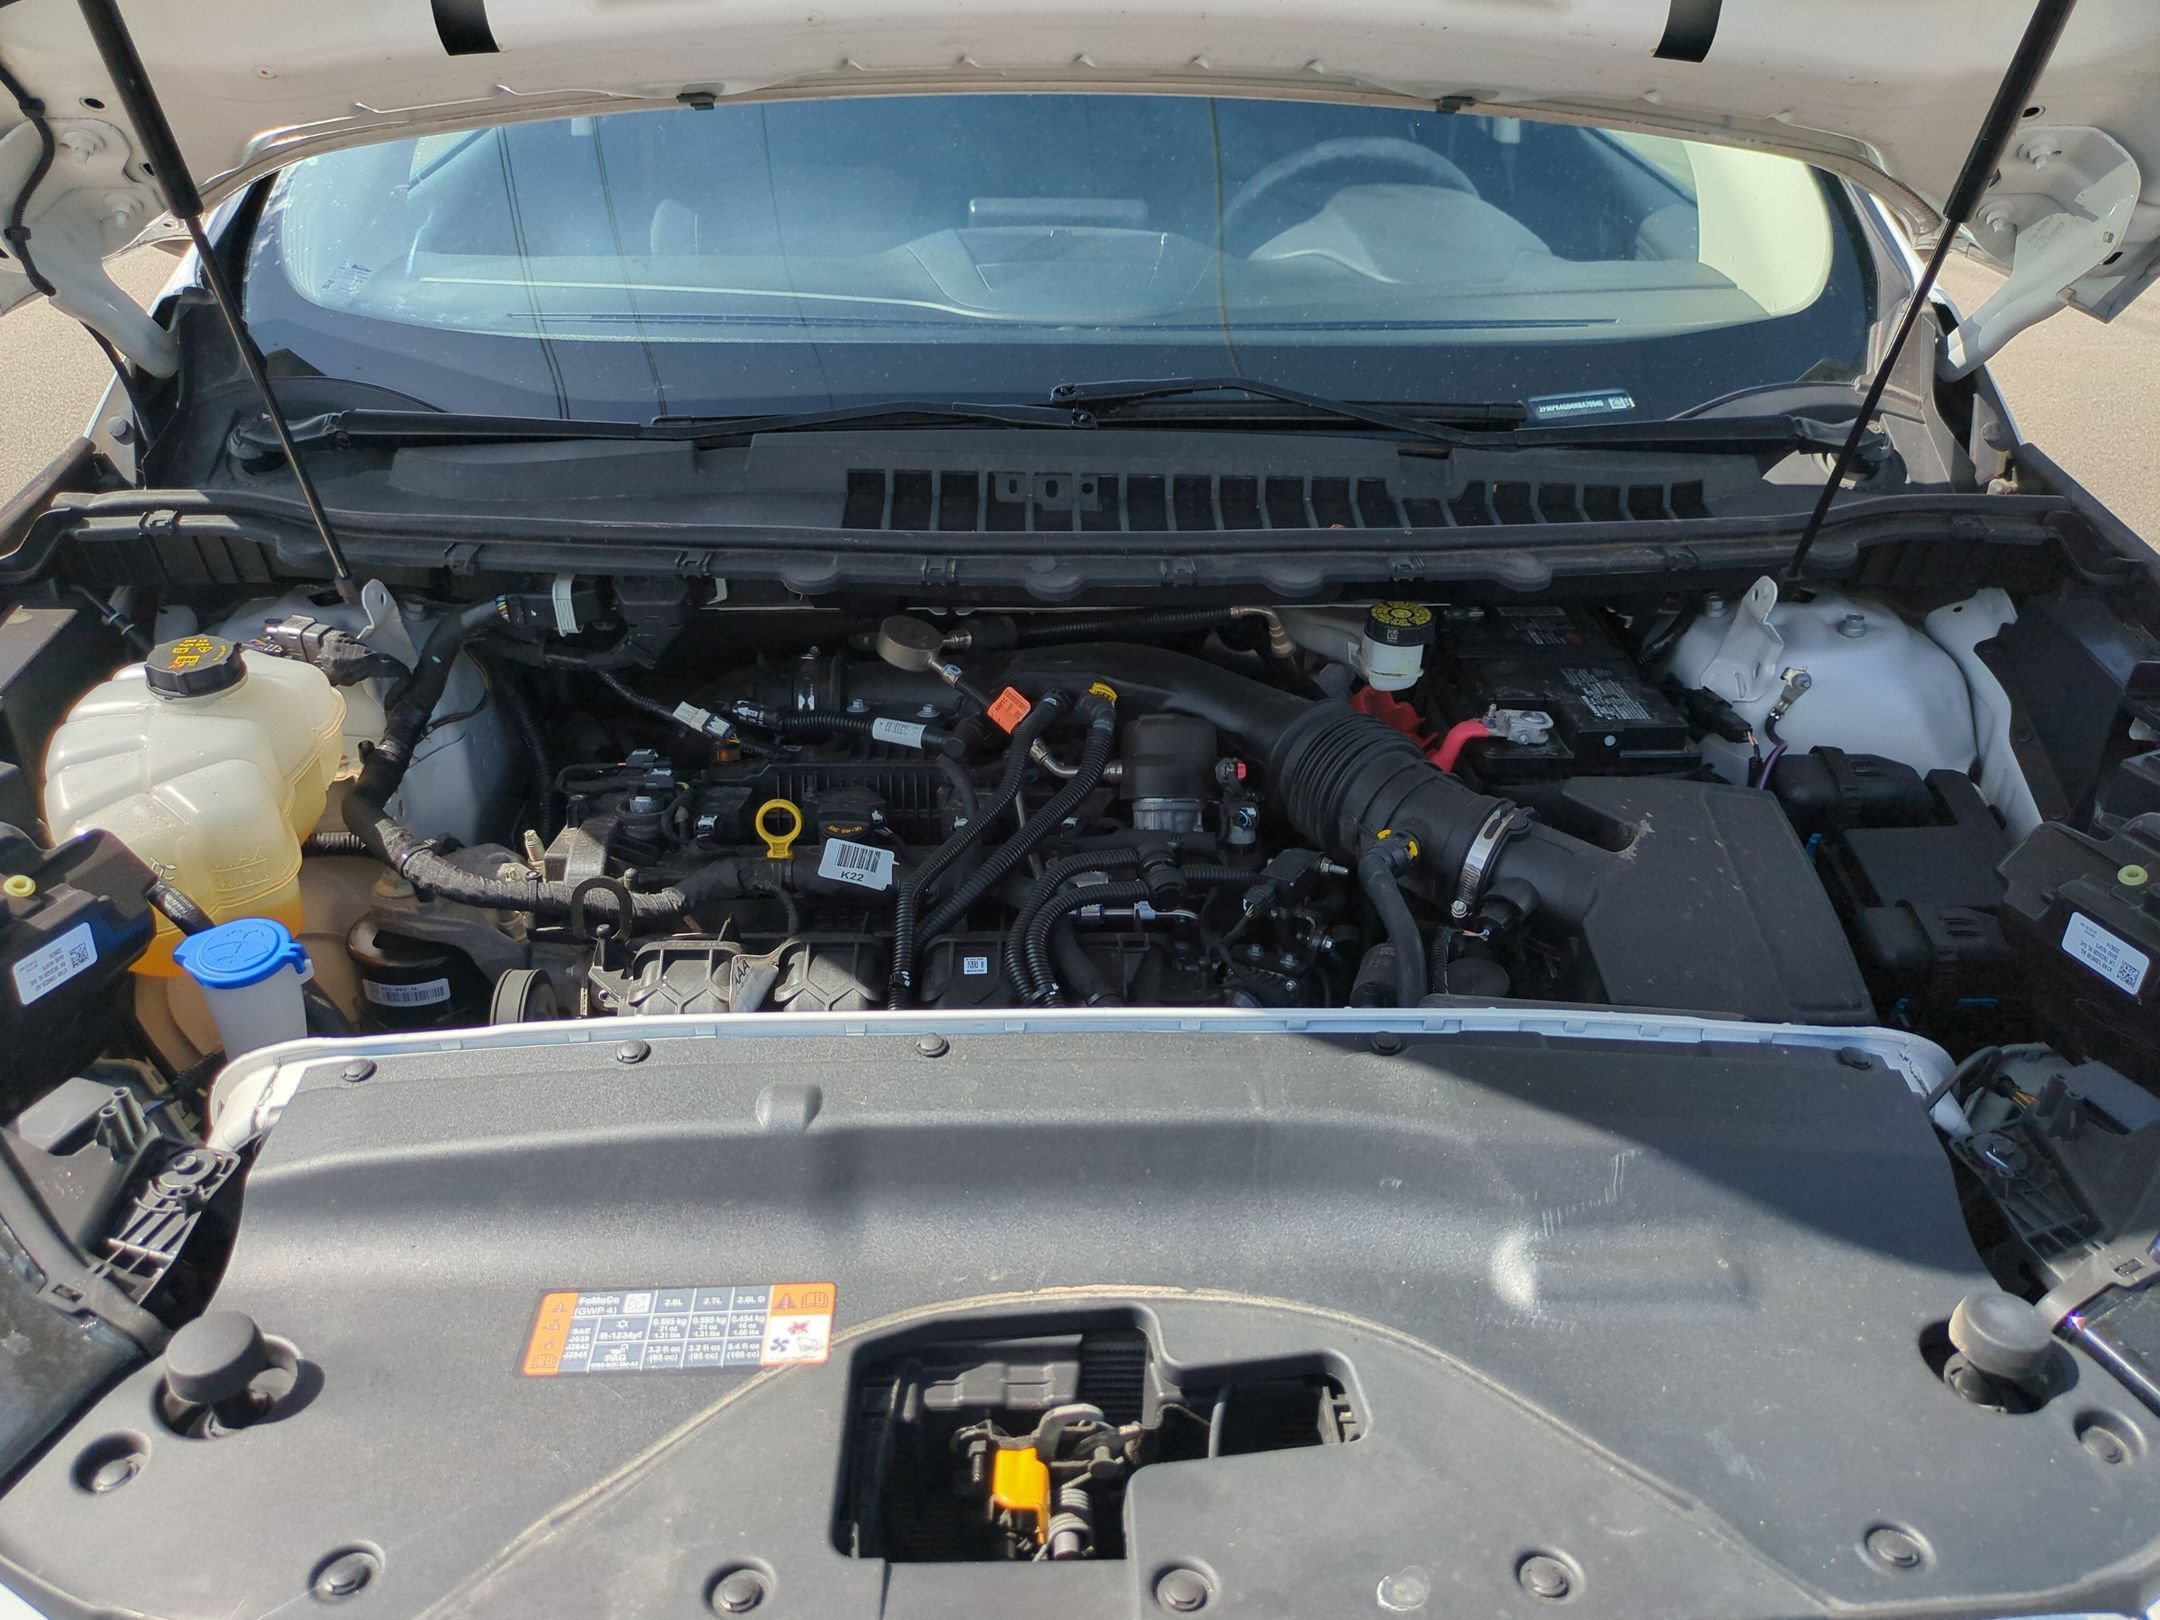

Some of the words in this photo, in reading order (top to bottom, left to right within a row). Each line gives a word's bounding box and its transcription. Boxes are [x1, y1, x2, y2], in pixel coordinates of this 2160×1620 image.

[841, 871, 864, 882] K22
[579, 1296, 620, 1306] FoMoCo
[664, 1299, 684, 1307] 2.0L
[703, 1297, 722, 1305] 2.7L
[737, 1296, 756, 1304] 2.0L
[574, 1306, 605, 1316] (GWP
[606, 1306, 617, 1315] 4)
[676, 1318, 688, 1326] kg
[716, 1317, 727, 1325] kg
[754, 1315, 766, 1323] kg
[605, 1354, 627, 1362] PAG
